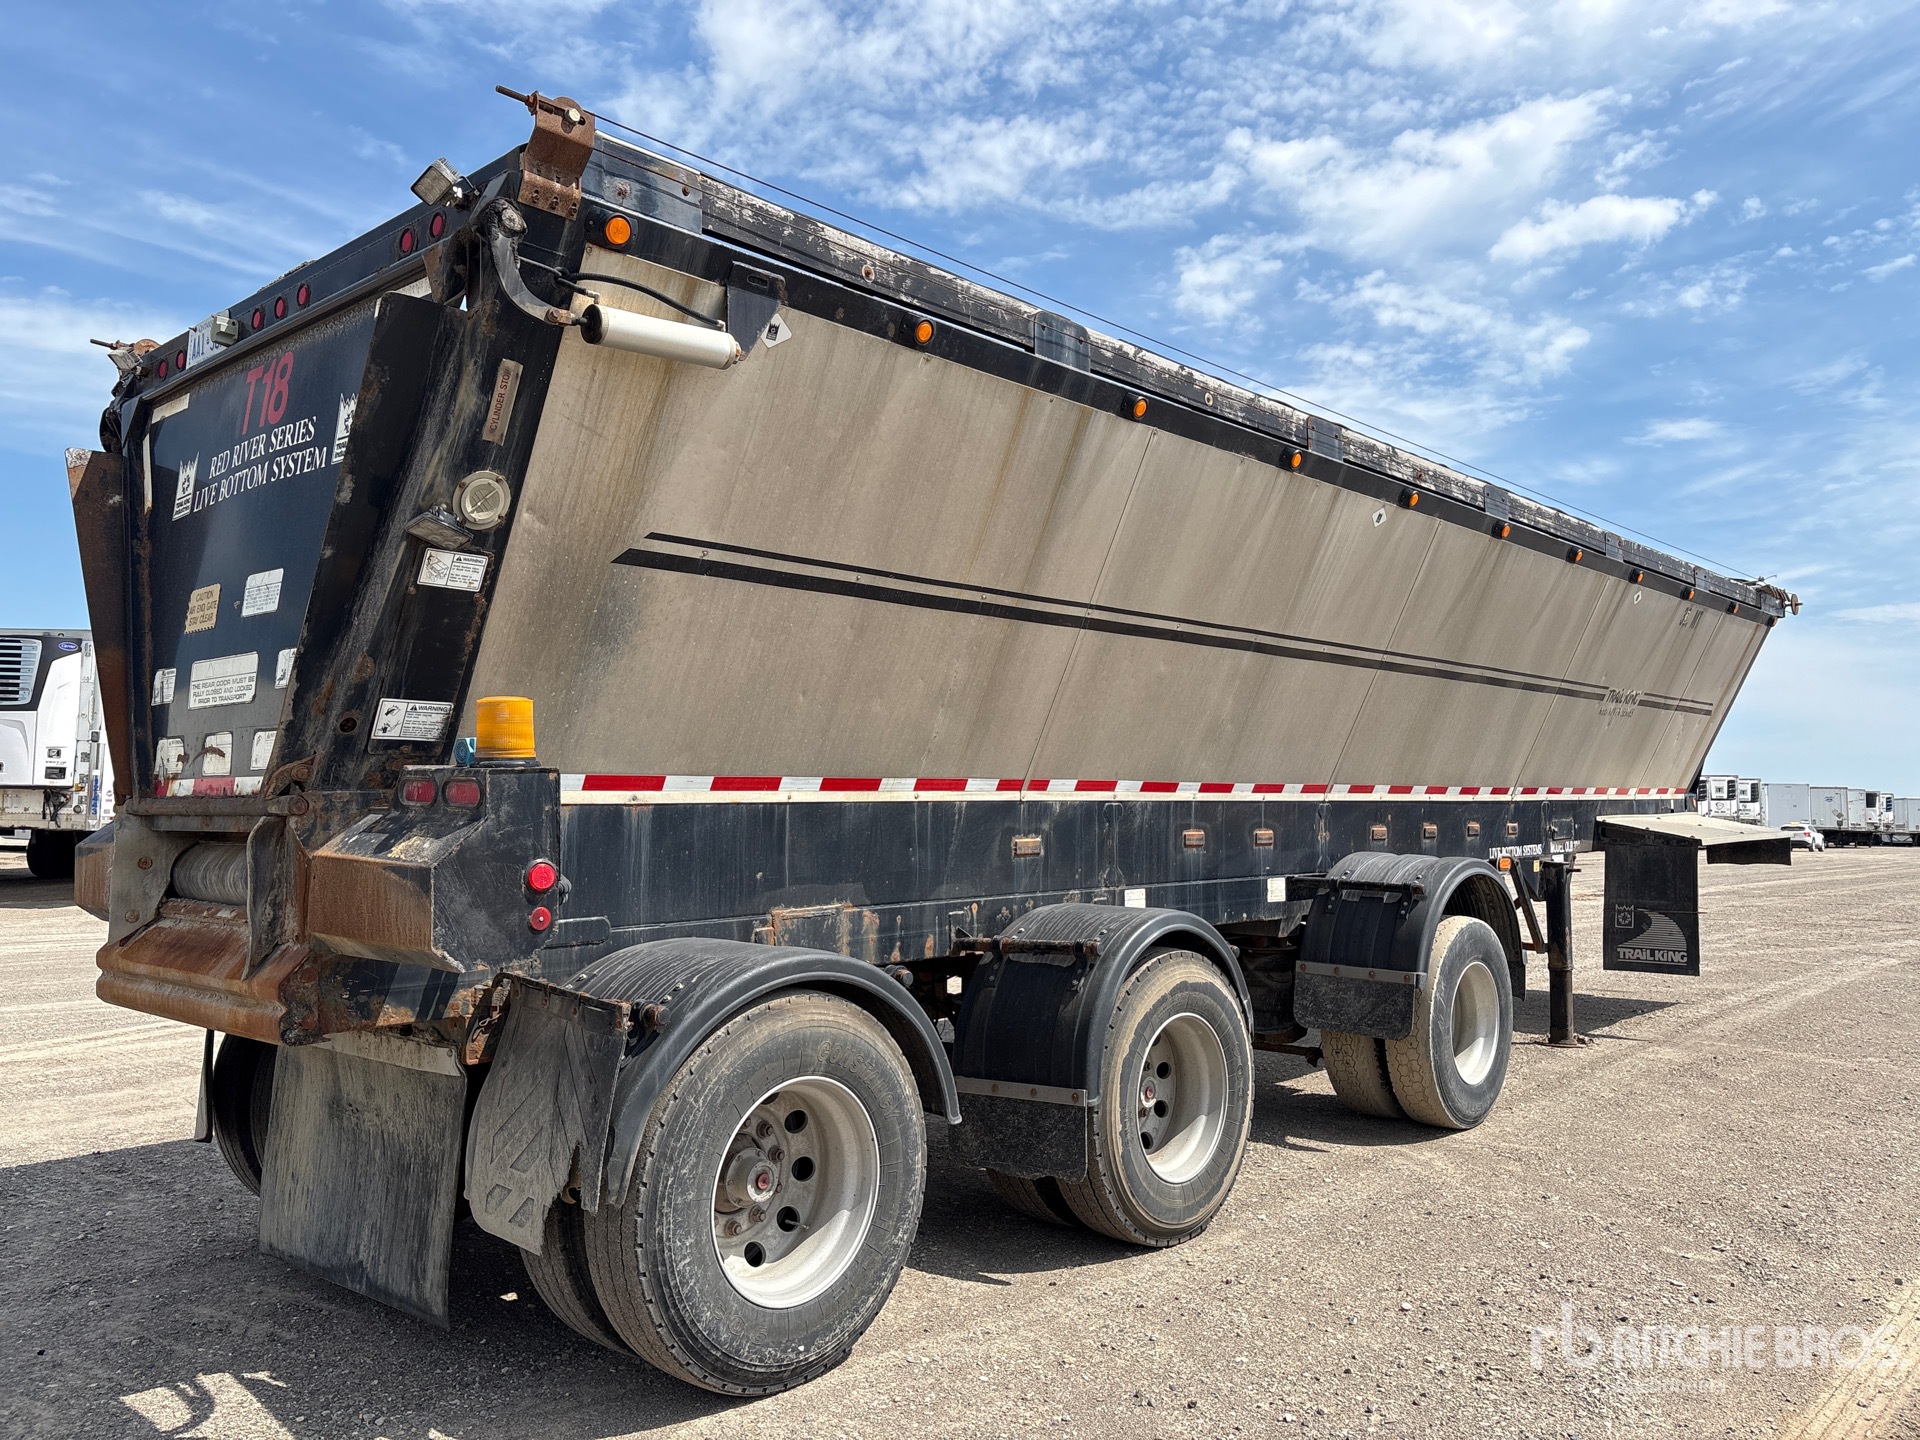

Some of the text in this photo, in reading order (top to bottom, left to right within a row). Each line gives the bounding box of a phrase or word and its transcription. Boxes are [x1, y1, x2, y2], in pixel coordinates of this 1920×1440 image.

[242, 351, 294, 435] T18
[489, 392, 506, 432] CYLINDER
[209, 450, 230, 479] RED
[231, 433, 266, 469] RIVER
[193, 482, 217, 513] LIVE
[217, 461, 269, 502] BOTTOM
[271, 446, 327, 482] SYSTEM
[195, 589, 214, 602] CAUTION
[206, 599, 217, 610] GATE
[192, 675, 255, 691] THE REAR DOOR MUST BE
[192, 690, 205, 698] FULLY
[205, 688, 222, 696] CLOSED
[234, 684, 253, 692] LOCKED
[418, 705, 449, 713] WARNING
[1522, 844, 1542, 856] SYSTEMS
